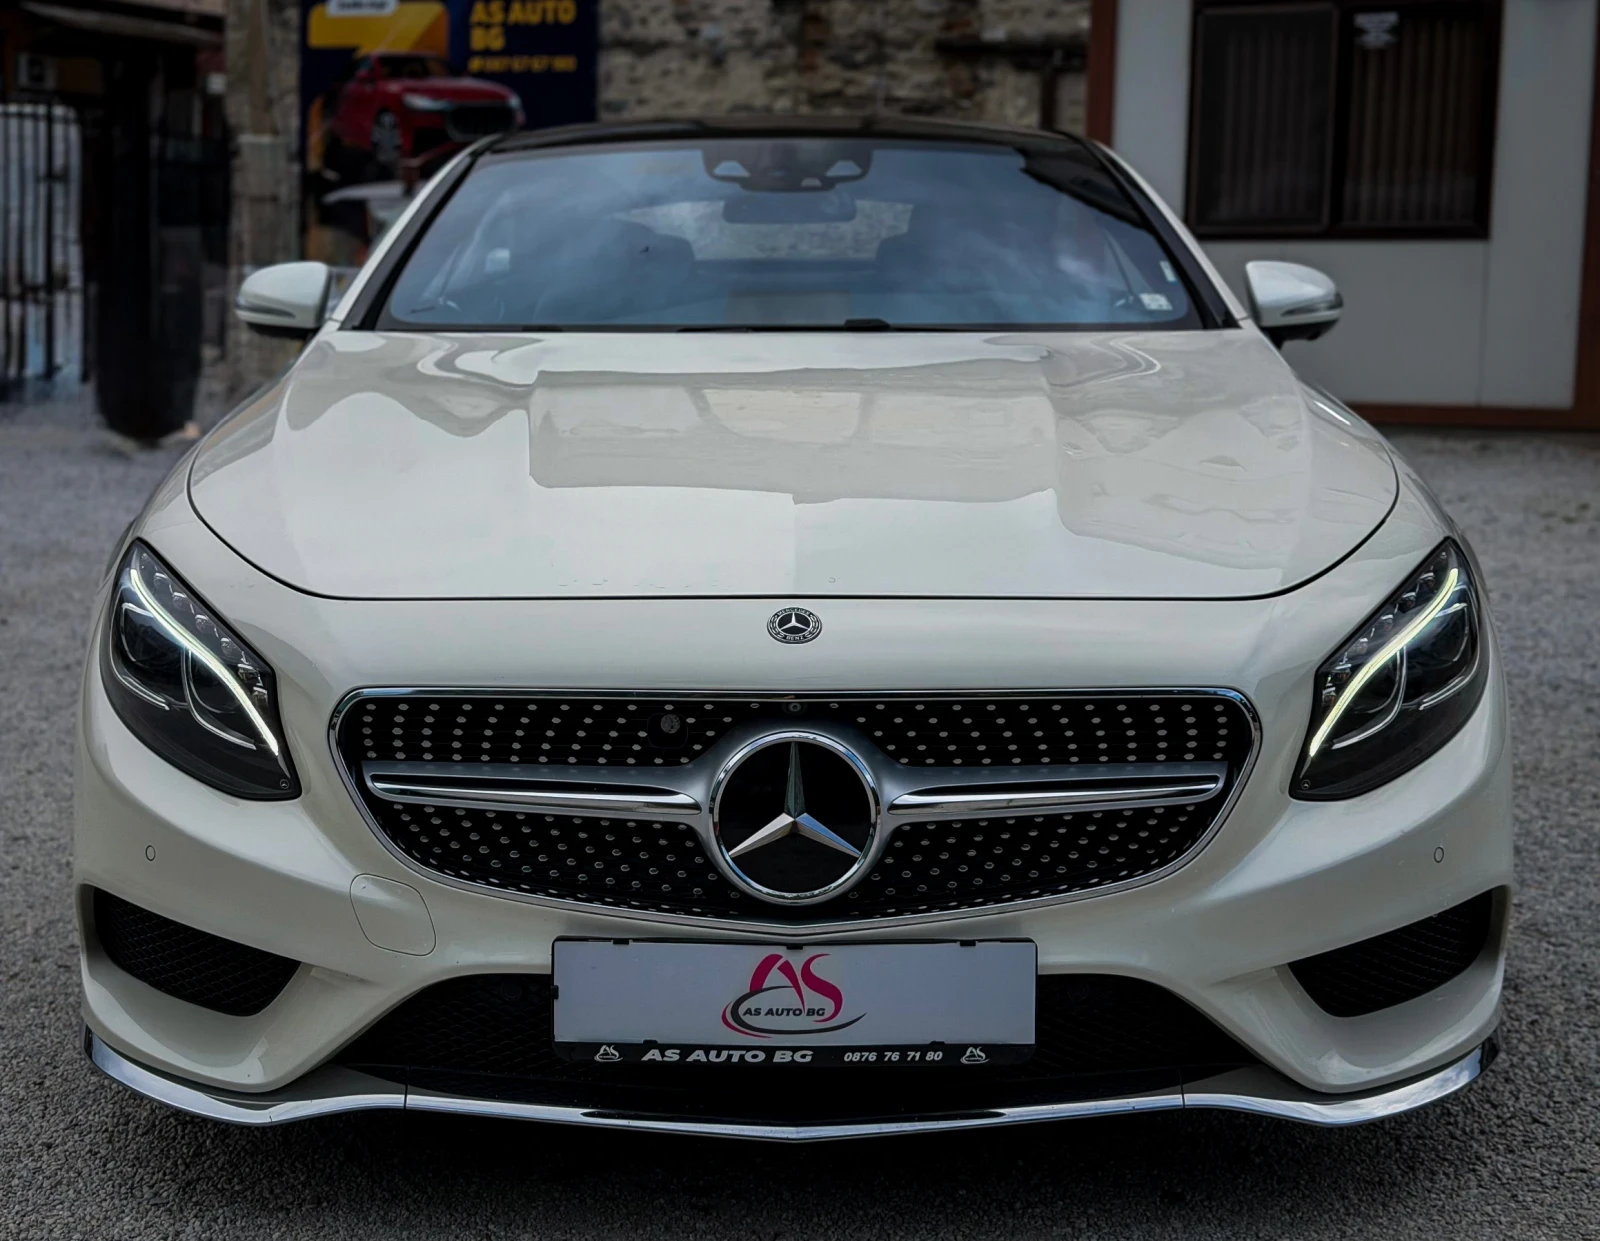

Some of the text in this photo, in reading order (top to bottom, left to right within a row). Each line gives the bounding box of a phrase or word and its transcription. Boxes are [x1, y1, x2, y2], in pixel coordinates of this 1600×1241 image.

[471, 0, 577, 24] AS AUTO
[749, 953, 843, 1023] AS
[743, 1007, 826, 1017] AS AUTO BG
[641, 1048, 814, 1063] AS AUTO BG
[843, 1051, 943, 1062] 0876 76 71 80
